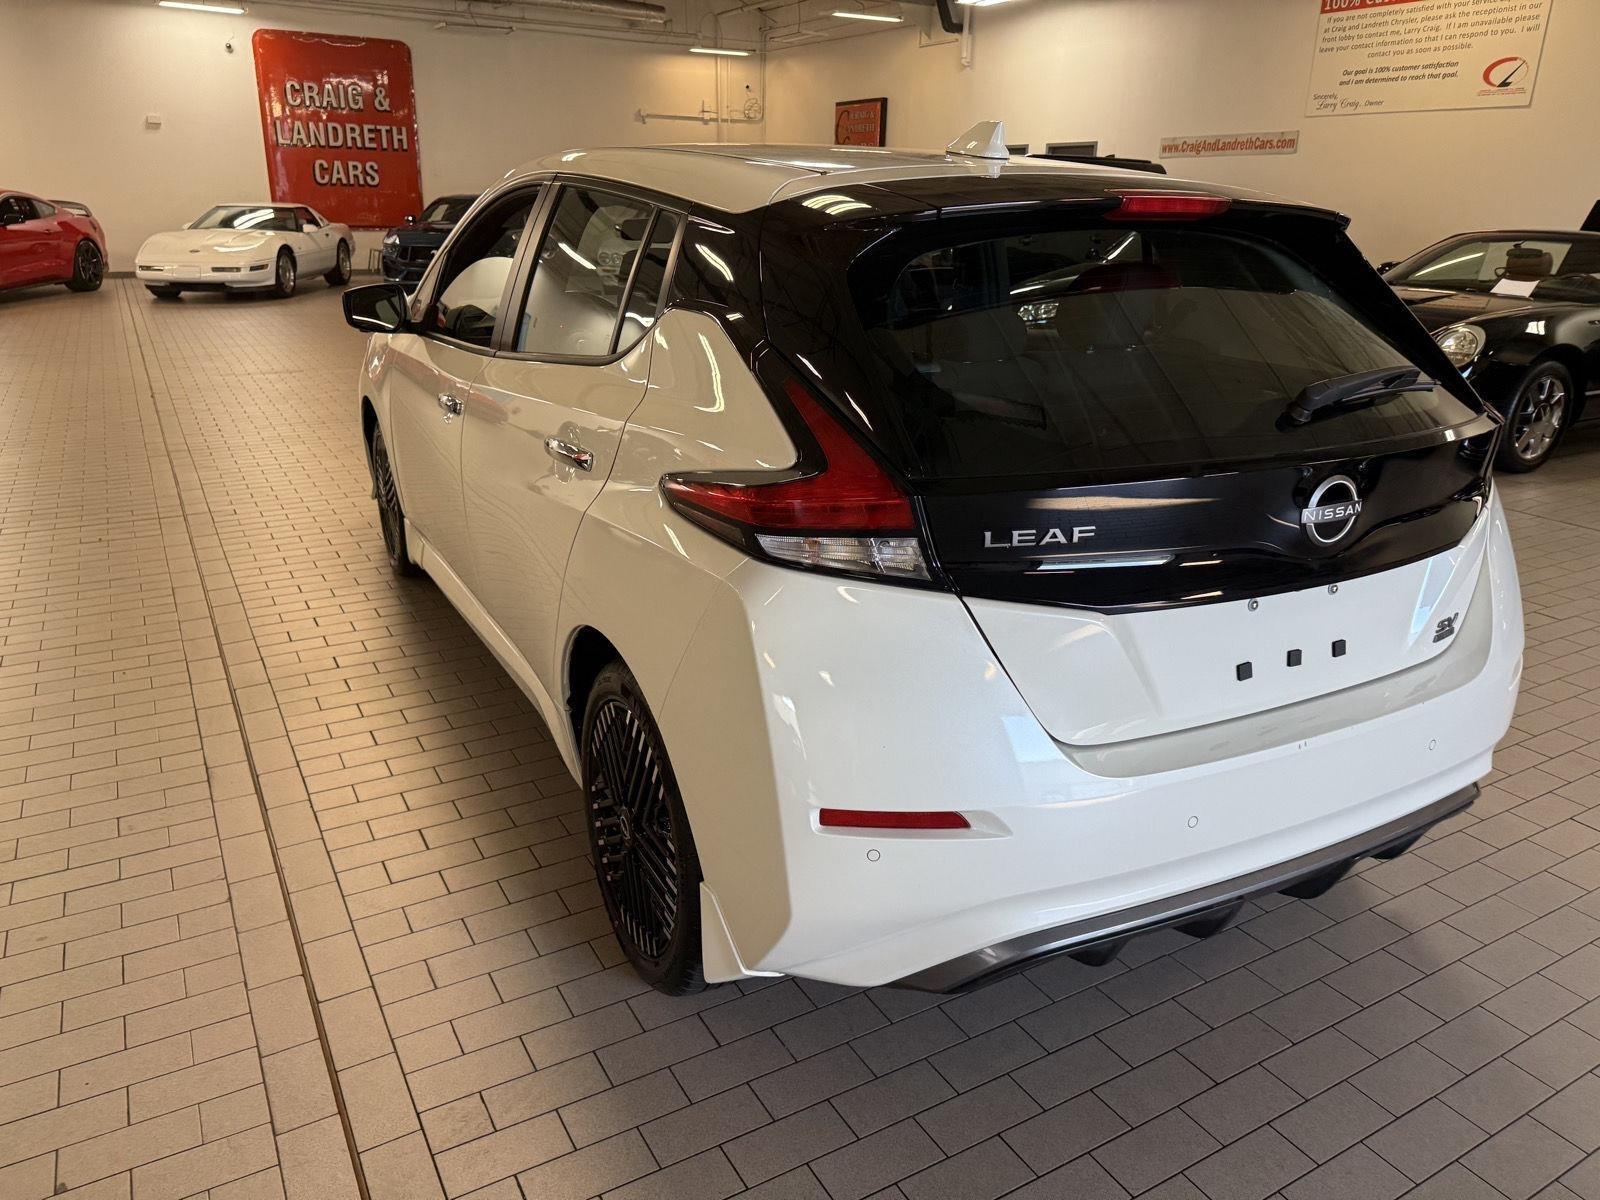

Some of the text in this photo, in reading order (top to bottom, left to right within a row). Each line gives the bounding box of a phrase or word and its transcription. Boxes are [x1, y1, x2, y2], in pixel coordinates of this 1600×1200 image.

[1331, 24, 1347, 33] Craig
[1348, 22, 1360, 31] and
[1361, 19, 1389, 30] Landreth
[1390, 15, 1419, 27] Chrysler,
[1420, 14, 1443, 24] please
[1444, 12, 1456, 20] ask
[1458, 9, 1470, 18] the
[1472, 4, 1517, 17] receptionist
[1519, 2, 1527, 11] in
[1333, 16, 1345, 24] you
[1369, 7, 1405, 19] completely
[1406, 4, 1435, 14] satisfied
[1436, 1, 1452, 10] with
[1453, 0, 1470, 9] your
[1318, 46, 1335, 54] leave
[1335, 45, 1350, 53] your
[1350, 41, 1374, 51] contact
[1375, 36, 1415, 48] information
[1424, 34, 1439, 43] that
[1444, 32, 1457, 41] can
[1458, 28, 1489, 40] respond
[1490, 28, 1499, 36] to
[1499, 26, 1517, 36] you.
[1526, 23, 1541, 32] will
[1322, 35, 1337, 43] front
[1338, 33, 1355, 43] lobby
[1356, 32, 1364, 40] to
[1364, 29, 1388, 39] contact
[1403, 25, 1421, 36] Larry
[1457, 21, 1469, 29] am
[1470, 16, 1513, 27] unavailable
[1514, 13, 1541, 24] please
[1367, 49, 1392, 59] contact
[1392, 48, 1405, 57] you
[1405, 47, 1414, 55] as
[1414, 45, 1432, 54] soon
[1442, 41, 1474, 53] possible.
[1338, 79, 1351, 87] and
[1364, 74, 1400, 85] determined
[1400, 74, 1408, 82] to
[1408, 72, 1426, 81] reach
[1426, 71, 1441, 80] that
[1441, 70, 1459, 80] goal.
[1342, 60, 1459, 77] Our goal is 100% customer satisfaction
[285, 80, 391, 112] CRAIG &
[1314, 100, 1338, 112] Larry
[1364, 98, 1385, 107] Owner
[274, 120, 408, 151] LANDRETH
[1161, 136, 1296, 155] www.CraigAndLandrethCars.com
[314, 159, 380, 187] CARS
[1303, 501, 1362, 522] NISSAN
[984, 525, 1096, 549] LEAF
[1435, 612, 1459, 634] SV
